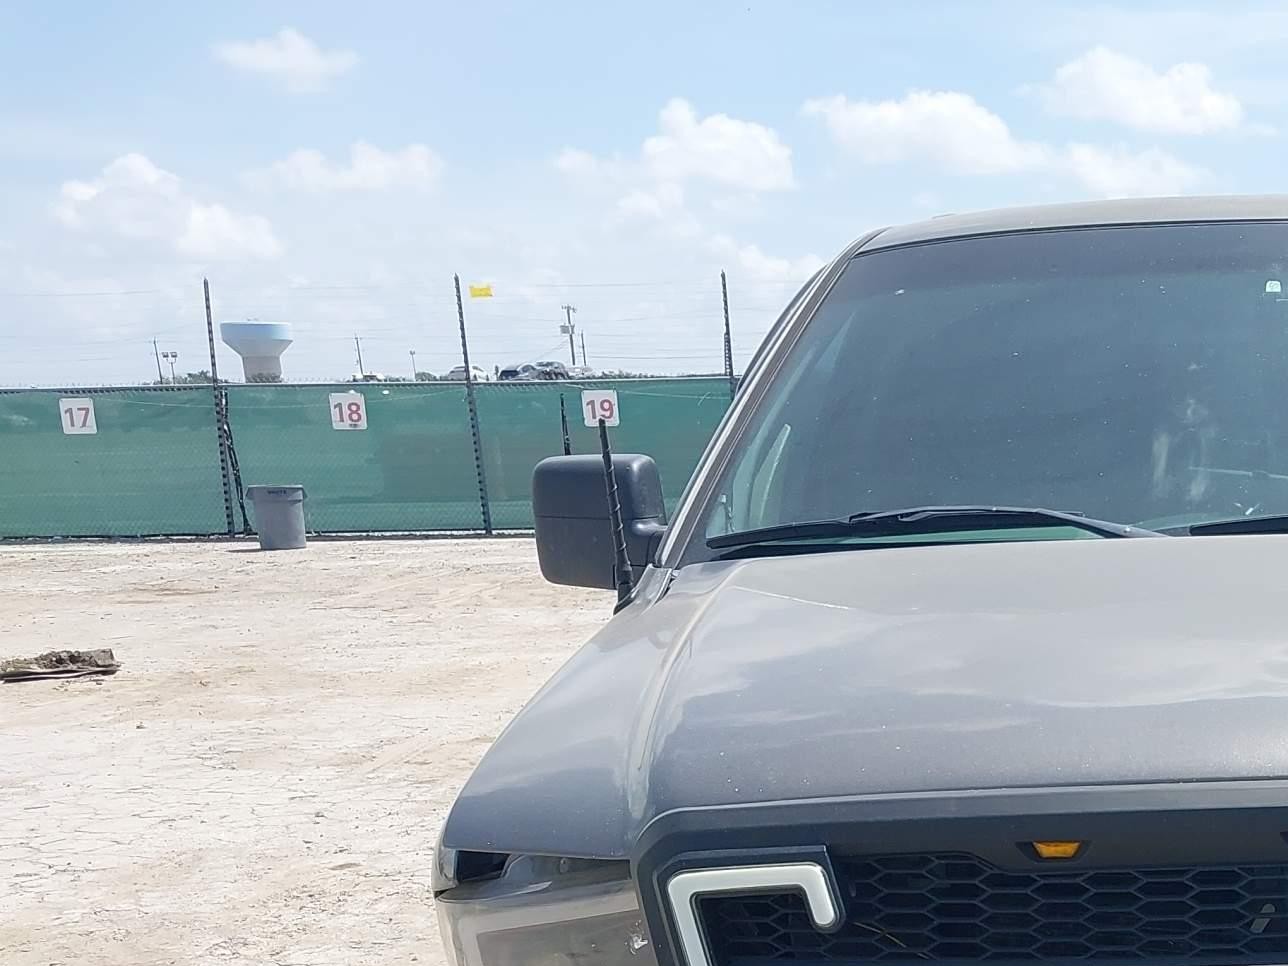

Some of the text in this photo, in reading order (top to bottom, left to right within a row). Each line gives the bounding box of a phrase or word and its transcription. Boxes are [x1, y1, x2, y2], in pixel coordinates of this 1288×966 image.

[64, 407, 90, 428] 17
[333, 402, 361, 423] 18
[586, 399, 614, 419] 19
